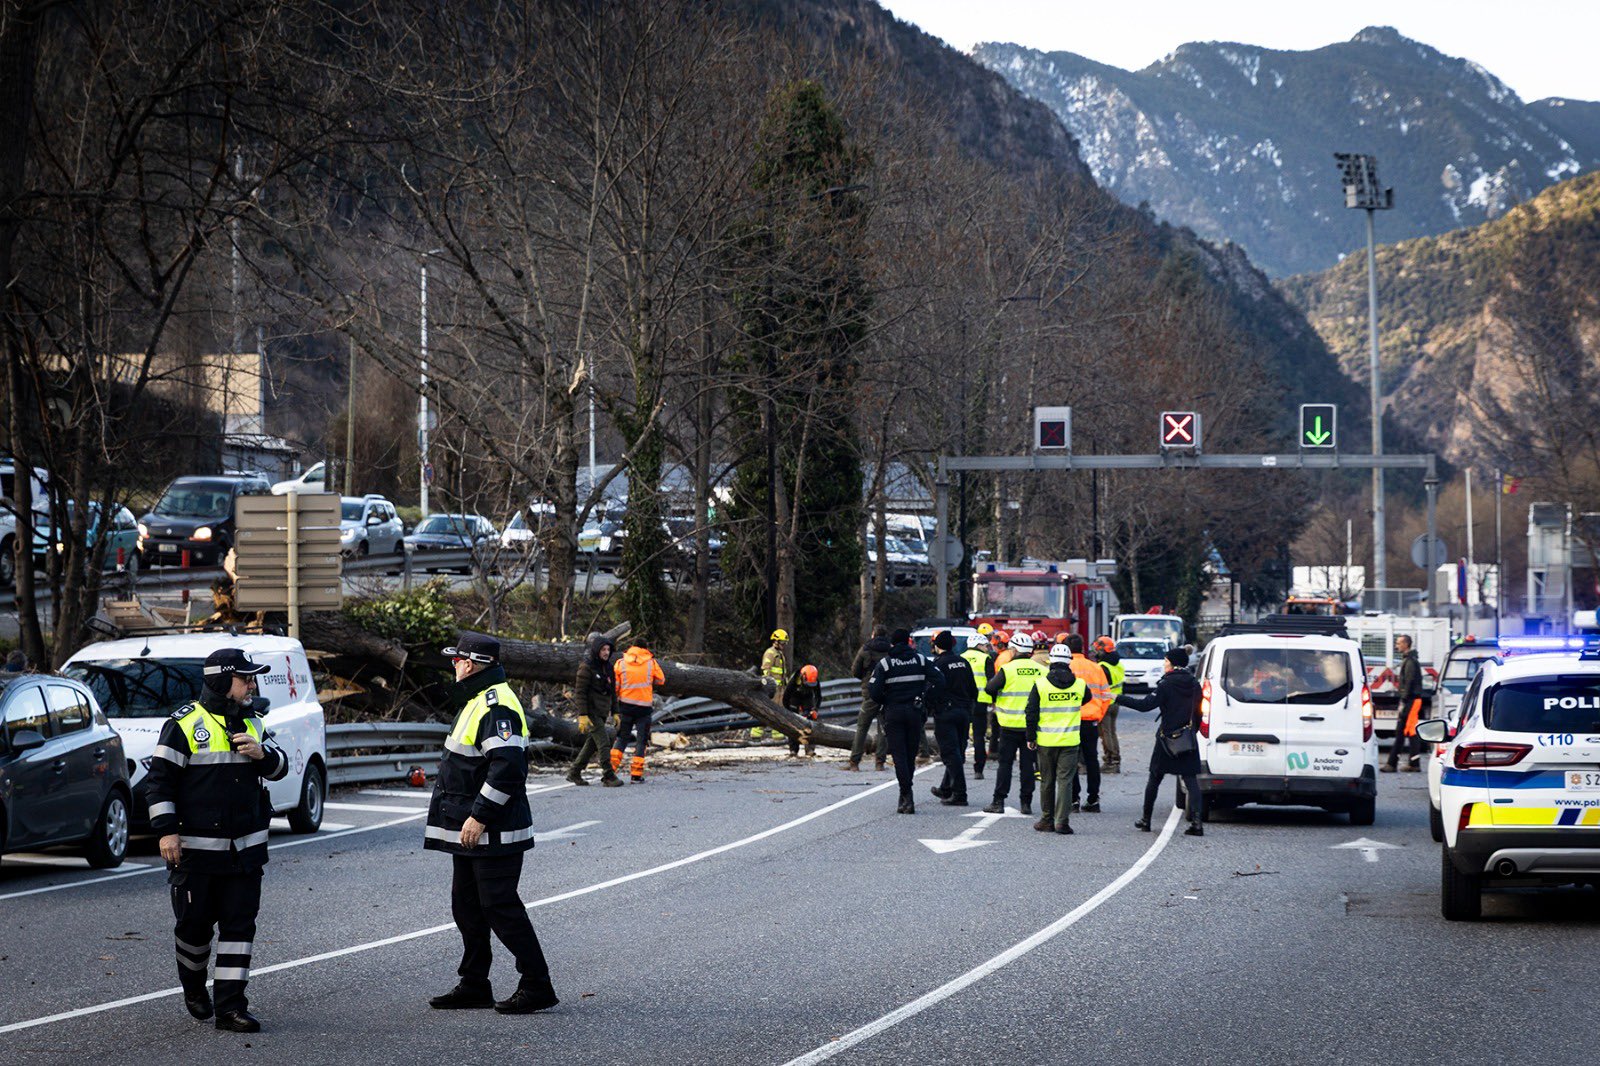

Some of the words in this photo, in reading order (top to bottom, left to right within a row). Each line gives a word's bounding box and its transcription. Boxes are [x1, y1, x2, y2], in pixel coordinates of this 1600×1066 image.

[263, 674, 286, 685] EXPRESS
[1049, 693, 1070, 701] COEX
[1543, 696, 1600, 710] POLI
[1547, 733, 1574, 746] 110
